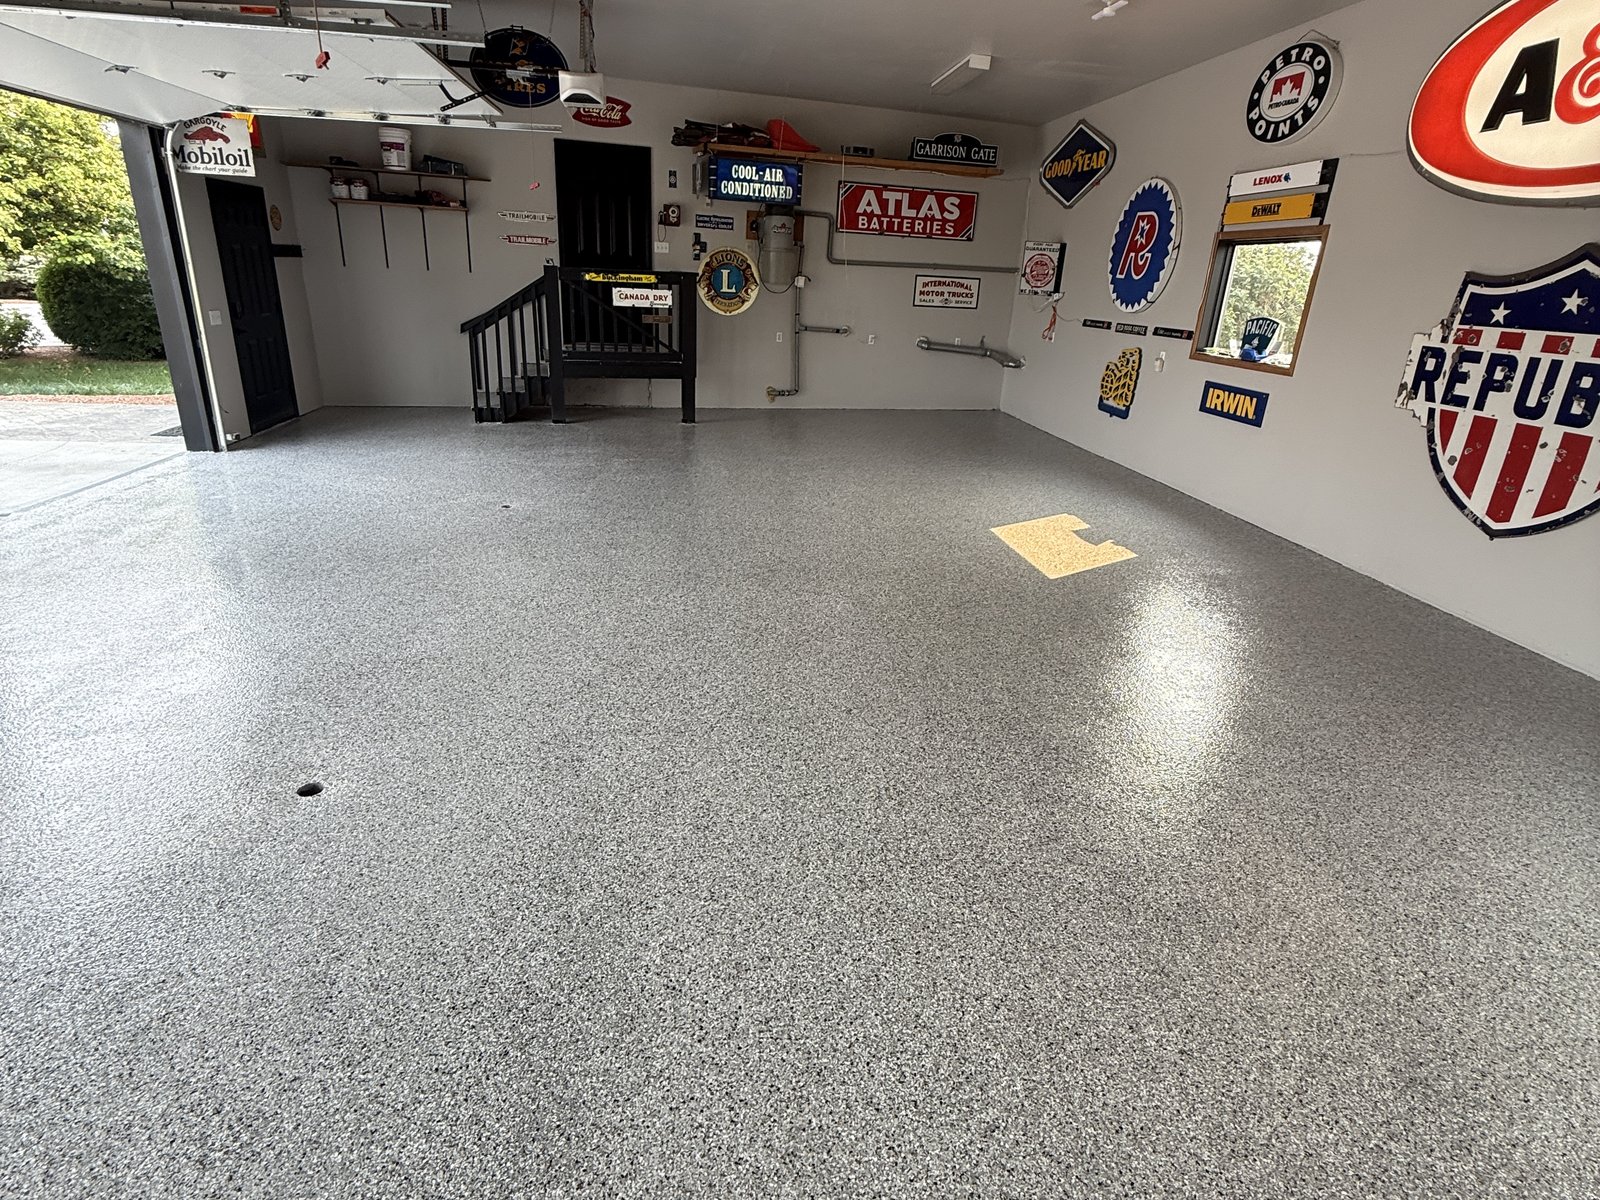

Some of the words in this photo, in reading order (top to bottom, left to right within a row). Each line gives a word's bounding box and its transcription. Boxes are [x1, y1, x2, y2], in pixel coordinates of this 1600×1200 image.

[1261, 47, 1325, 84] PETRO
[183, 117, 226, 132] GARGOYLE
[1249, 96, 1318, 140] POINTS
[172, 145, 251, 167] Mobiloil
[916, 142, 967, 158] GARRISON
[971, 147, 996, 161] GATE
[731, 164, 783, 182] COOL-AIR
[1253, 174, 1283, 186] LENOX
[720, 180, 793, 199] CONDITIONED
[856, 189, 960, 220] ATLAS
[858, 215, 955, 235] BATTERIES
[714, 253, 747, 268] LIONS
[720, 270, 736, 293] L
[922, 280, 973, 292] INTERNATIONAL
[619, 293, 650, 301] CANADA
[653, 294, 669, 302] DRY
[947, 291, 974, 299] TRUCKS
[1246, 319, 1278, 338] PACIFIC
[1205, 388, 1256, 420] IRWIN
